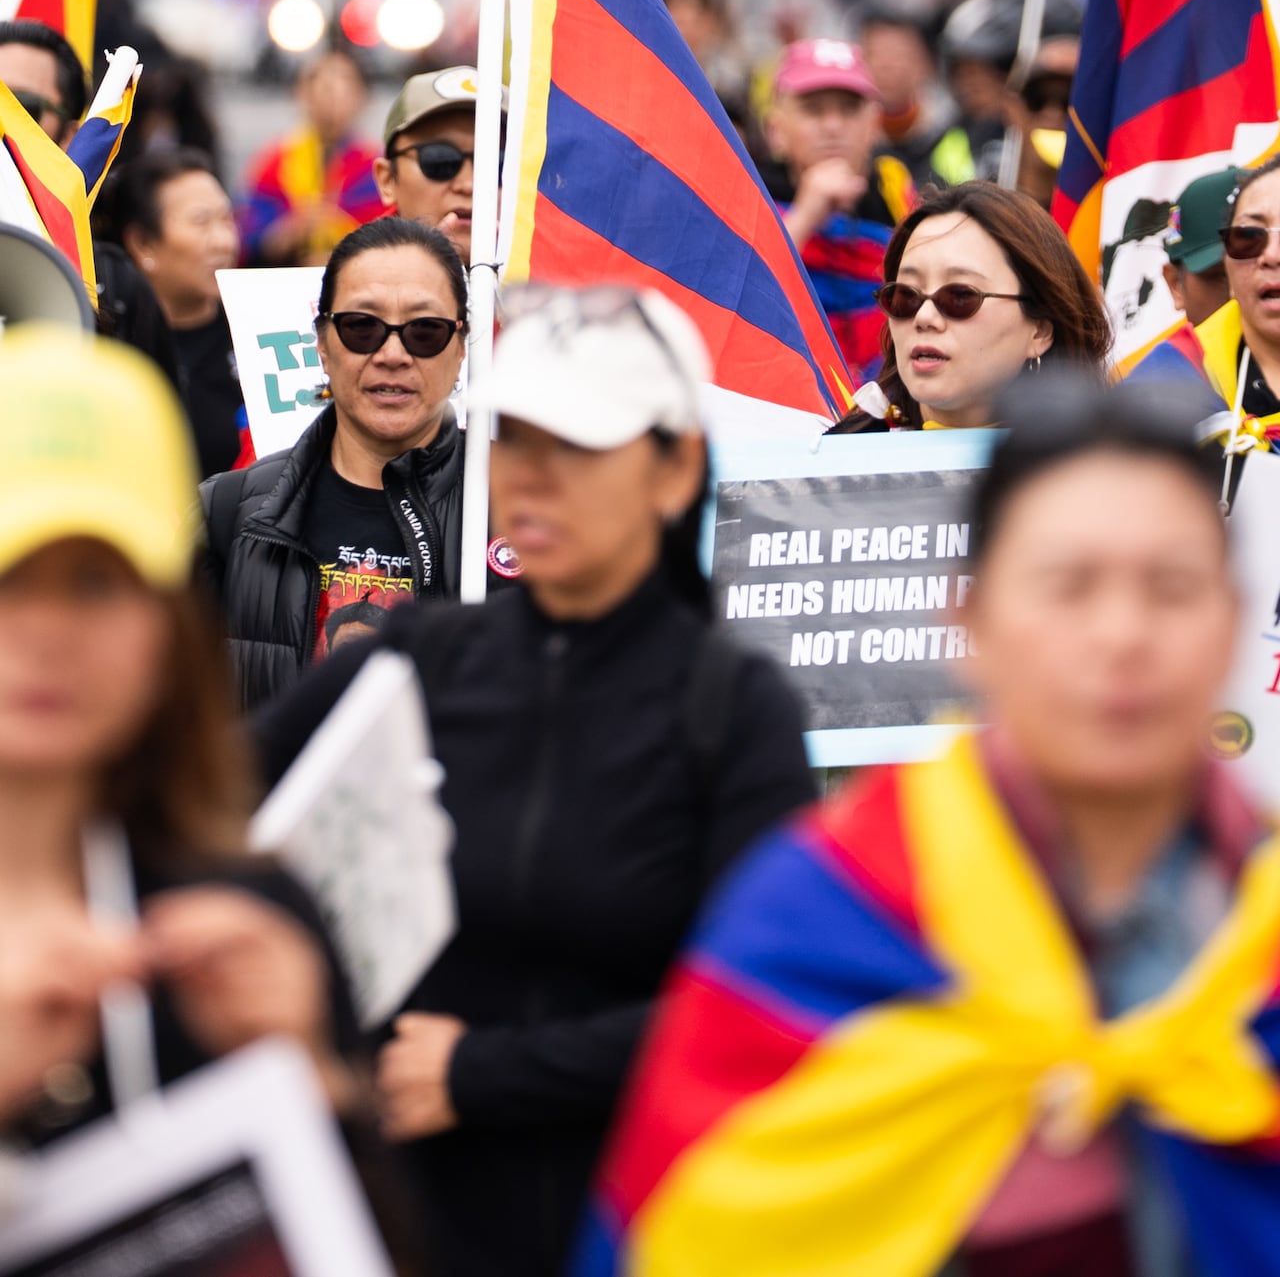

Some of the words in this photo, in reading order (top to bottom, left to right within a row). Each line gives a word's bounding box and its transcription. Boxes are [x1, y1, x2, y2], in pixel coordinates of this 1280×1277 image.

[256, 330, 321, 371] Ti
[418, 541, 434, 587] GOOSE
[748, 529, 824, 567] REAL
[830, 524, 929, 563] PEACE
[935, 523, 970, 559] IN
[726, 580, 825, 620] NEEDS
[830, 575, 949, 614] HUMAN
[789, 630, 856, 667] NOT
[859, 626, 981, 664] CONTR
